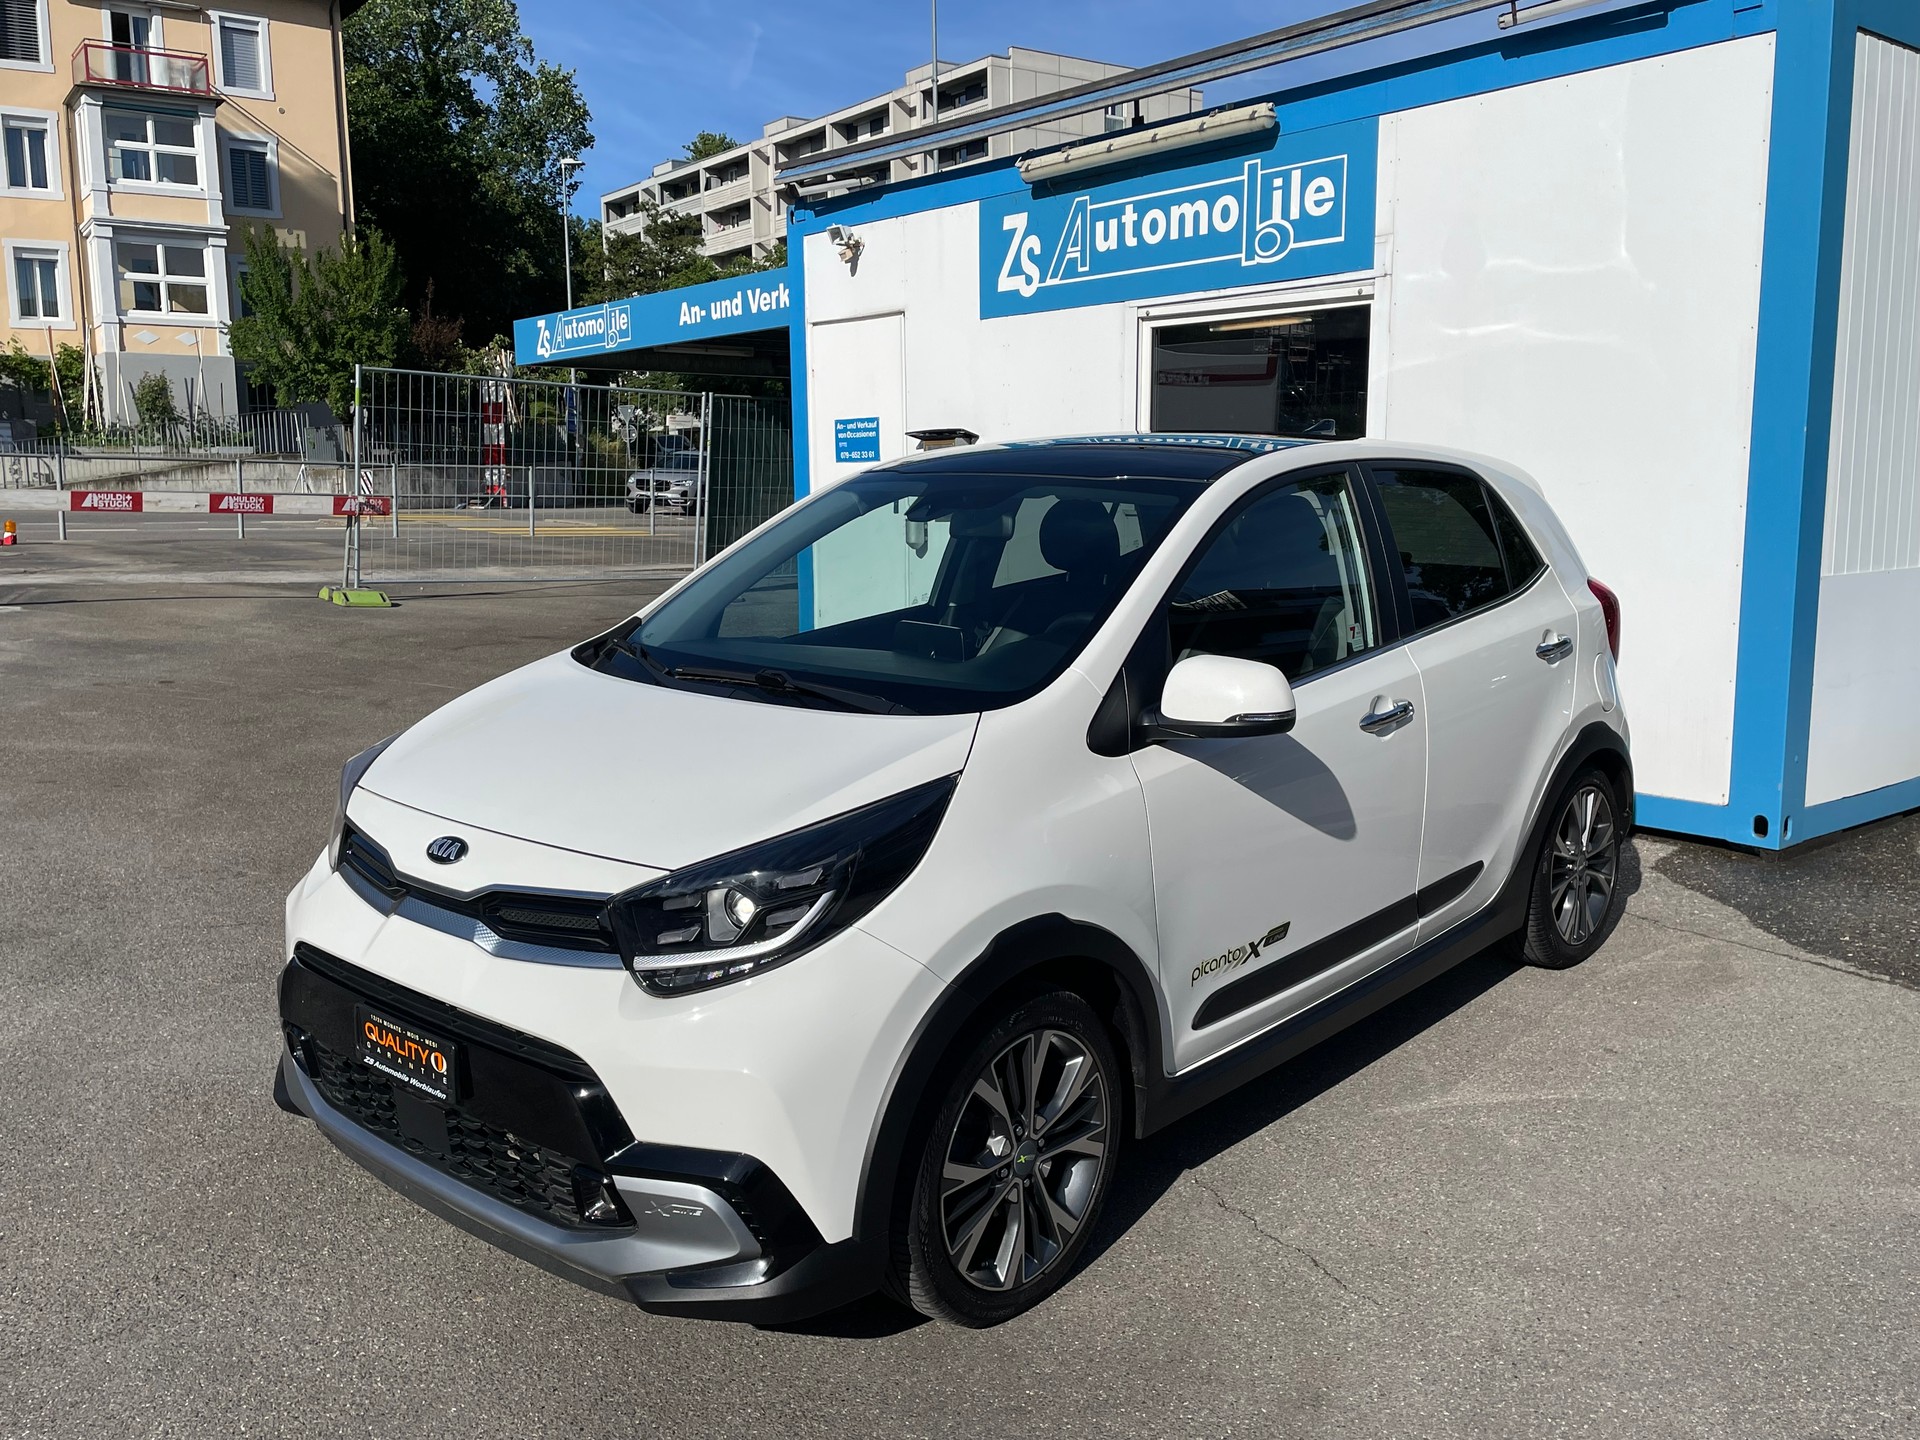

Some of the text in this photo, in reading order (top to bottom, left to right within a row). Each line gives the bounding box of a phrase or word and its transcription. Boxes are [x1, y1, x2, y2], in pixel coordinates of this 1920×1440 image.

[1045, 158, 1336, 284] Automobile
[679, 301, 706, 326] An-
[710, 290, 743, 320] und
[552, 303, 631, 352] Automobile
[428, 838, 462, 860] KIA
[1191, 948, 1242, 987] picanto
[373, 1061, 409, 1082] Automobile
